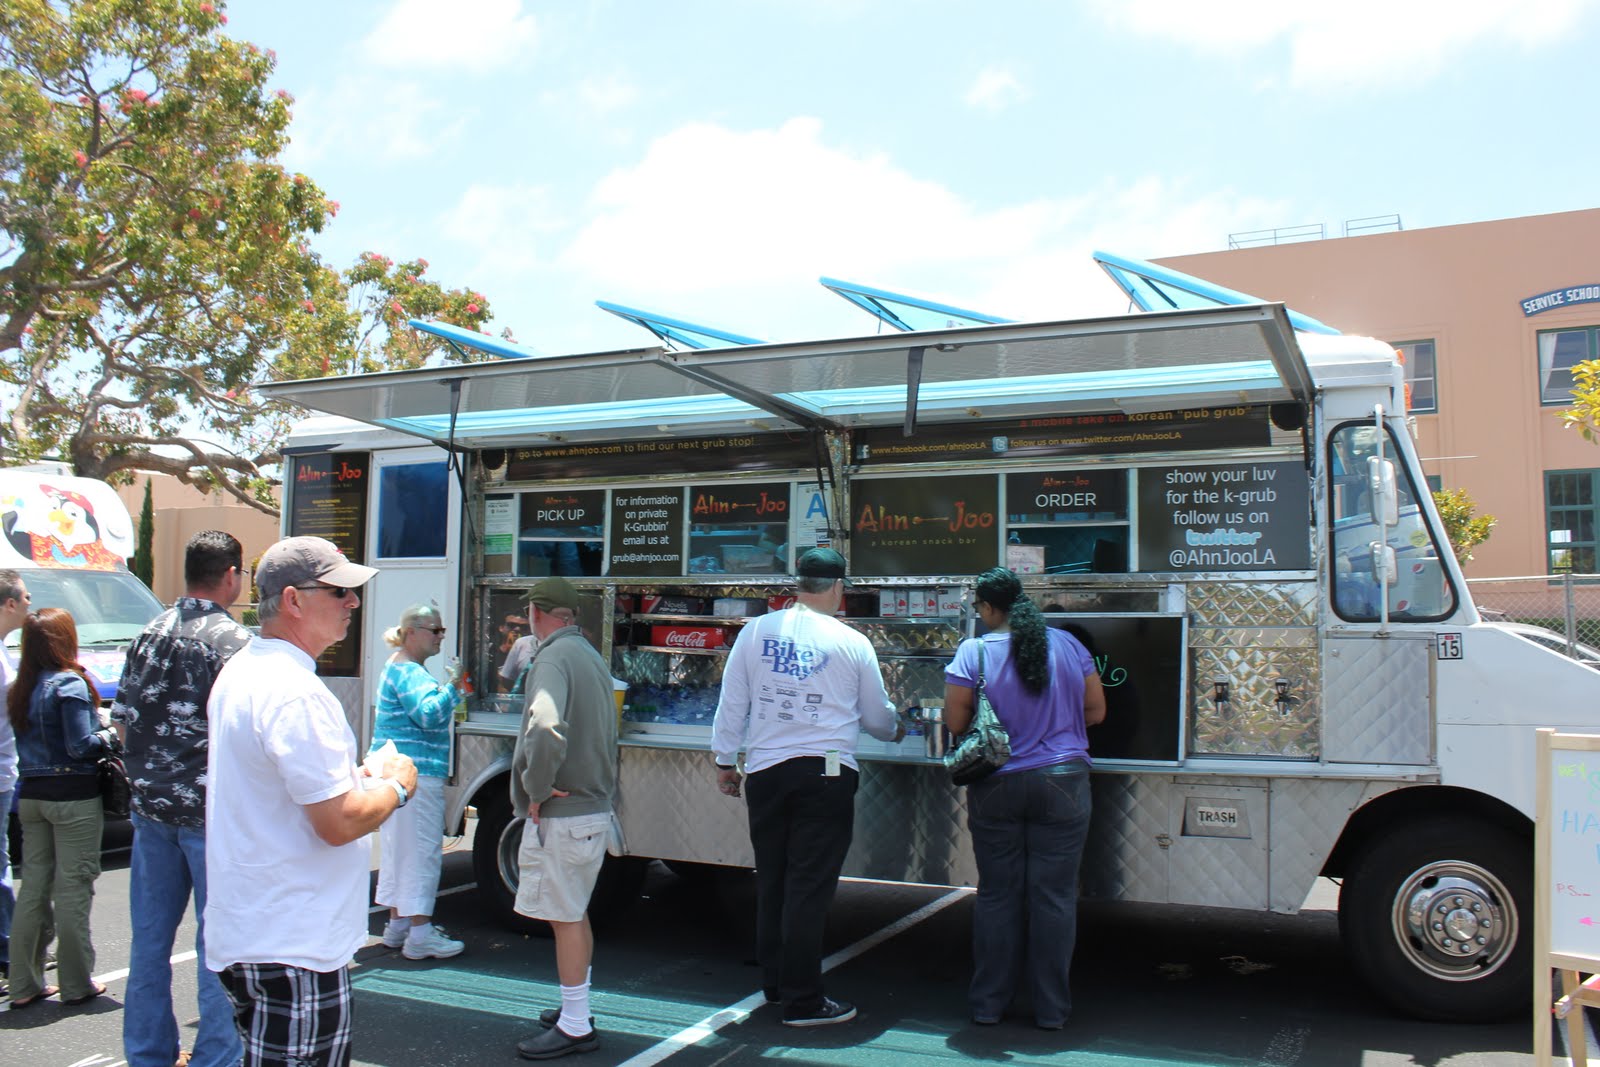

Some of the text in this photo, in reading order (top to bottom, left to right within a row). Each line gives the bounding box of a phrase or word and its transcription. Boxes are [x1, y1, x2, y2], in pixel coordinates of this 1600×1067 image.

[1524, 287, 1600, 313] SERVICE SCHOO
[1032, 418, 1072, 427] mobile
[1078, 415, 1104, 425] take
[1108, 415, 1124, 424] on
[1128, 411, 1172, 422] korean
[519, 452, 530, 460] go
[532, 450, 541, 458] to
[544, 445, 621, 457] www.ahnjoo.com
[624, 444, 634, 452] to
[637, 442, 655, 452] find
[678, 441, 698, 449] next
[702, 438, 726, 449] grub
[728, 437, 754, 448] stop!
[338, 462, 362, 481] Joo
[1166, 466, 1276, 486] show your luv
[616, 495, 678, 506] for information
[693, 492, 786, 514] Ahn Joo
[806, 493, 828, 519] A
[1036, 492, 1096, 507] ORDER
[1166, 488, 1276, 506] for the k-grub
[537, 508, 584, 521] PICK UP
[638, 509, 668, 520] private
[856, 501, 994, 532] Ahn Joo
[1174, 510, 1269, 524] follow us on
[624, 522, 669, 532] K-Grubbin'
[623, 536, 670, 545] email us at
[1186, 528, 1262, 546] twitter
[612, 553, 680, 564] grub@ahnjoo.com
[1170, 548, 1276, 567] @AhnJooLA
[762, 639, 814, 662] Bike
[1441, 640, 1459, 657] 15
[771, 656, 814, 680] Bay
[1198, 811, 1236, 823] TRASH
